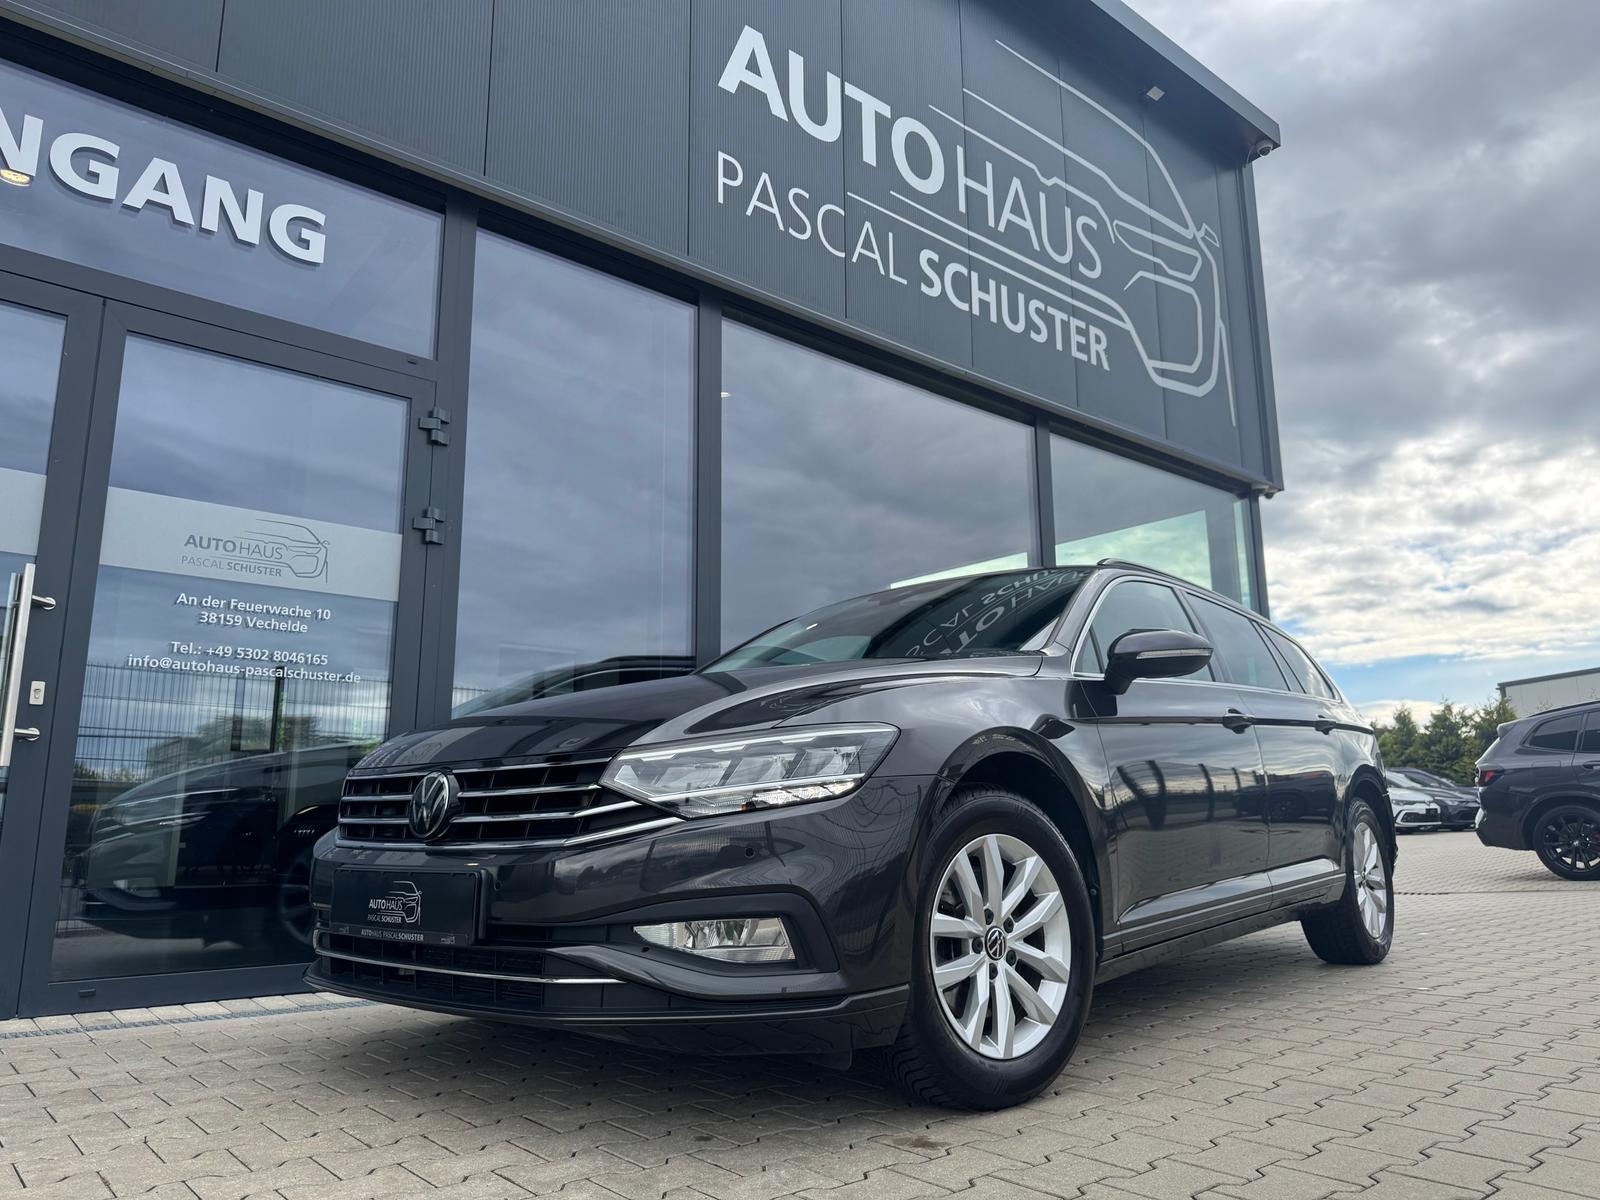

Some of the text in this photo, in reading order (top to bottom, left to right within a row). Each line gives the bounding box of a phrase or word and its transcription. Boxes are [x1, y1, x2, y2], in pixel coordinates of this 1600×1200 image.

[717, 25, 1102, 280] AUTOHAUS
[717, 151, 1110, 371] PASCAL SCHUSTER
[184, 534, 283, 560] AUTOHAUS
[181, 554, 282, 577] PASCAL SCHUSTER
[176, 593, 331, 620] An der Feuerwache 10
[199, 612, 308, 633] 38159 Vechelde
[171, 641, 329, 665] Tel.: +49 5302 8046165
[127, 654, 361, 684] info@autohaus-pascalschuster.de
[368, 898, 404, 911] AUTOHAUS
[381, 915, 402, 924] SCHUSTER
[361, 929, 382, 938] AUTOHAUS
